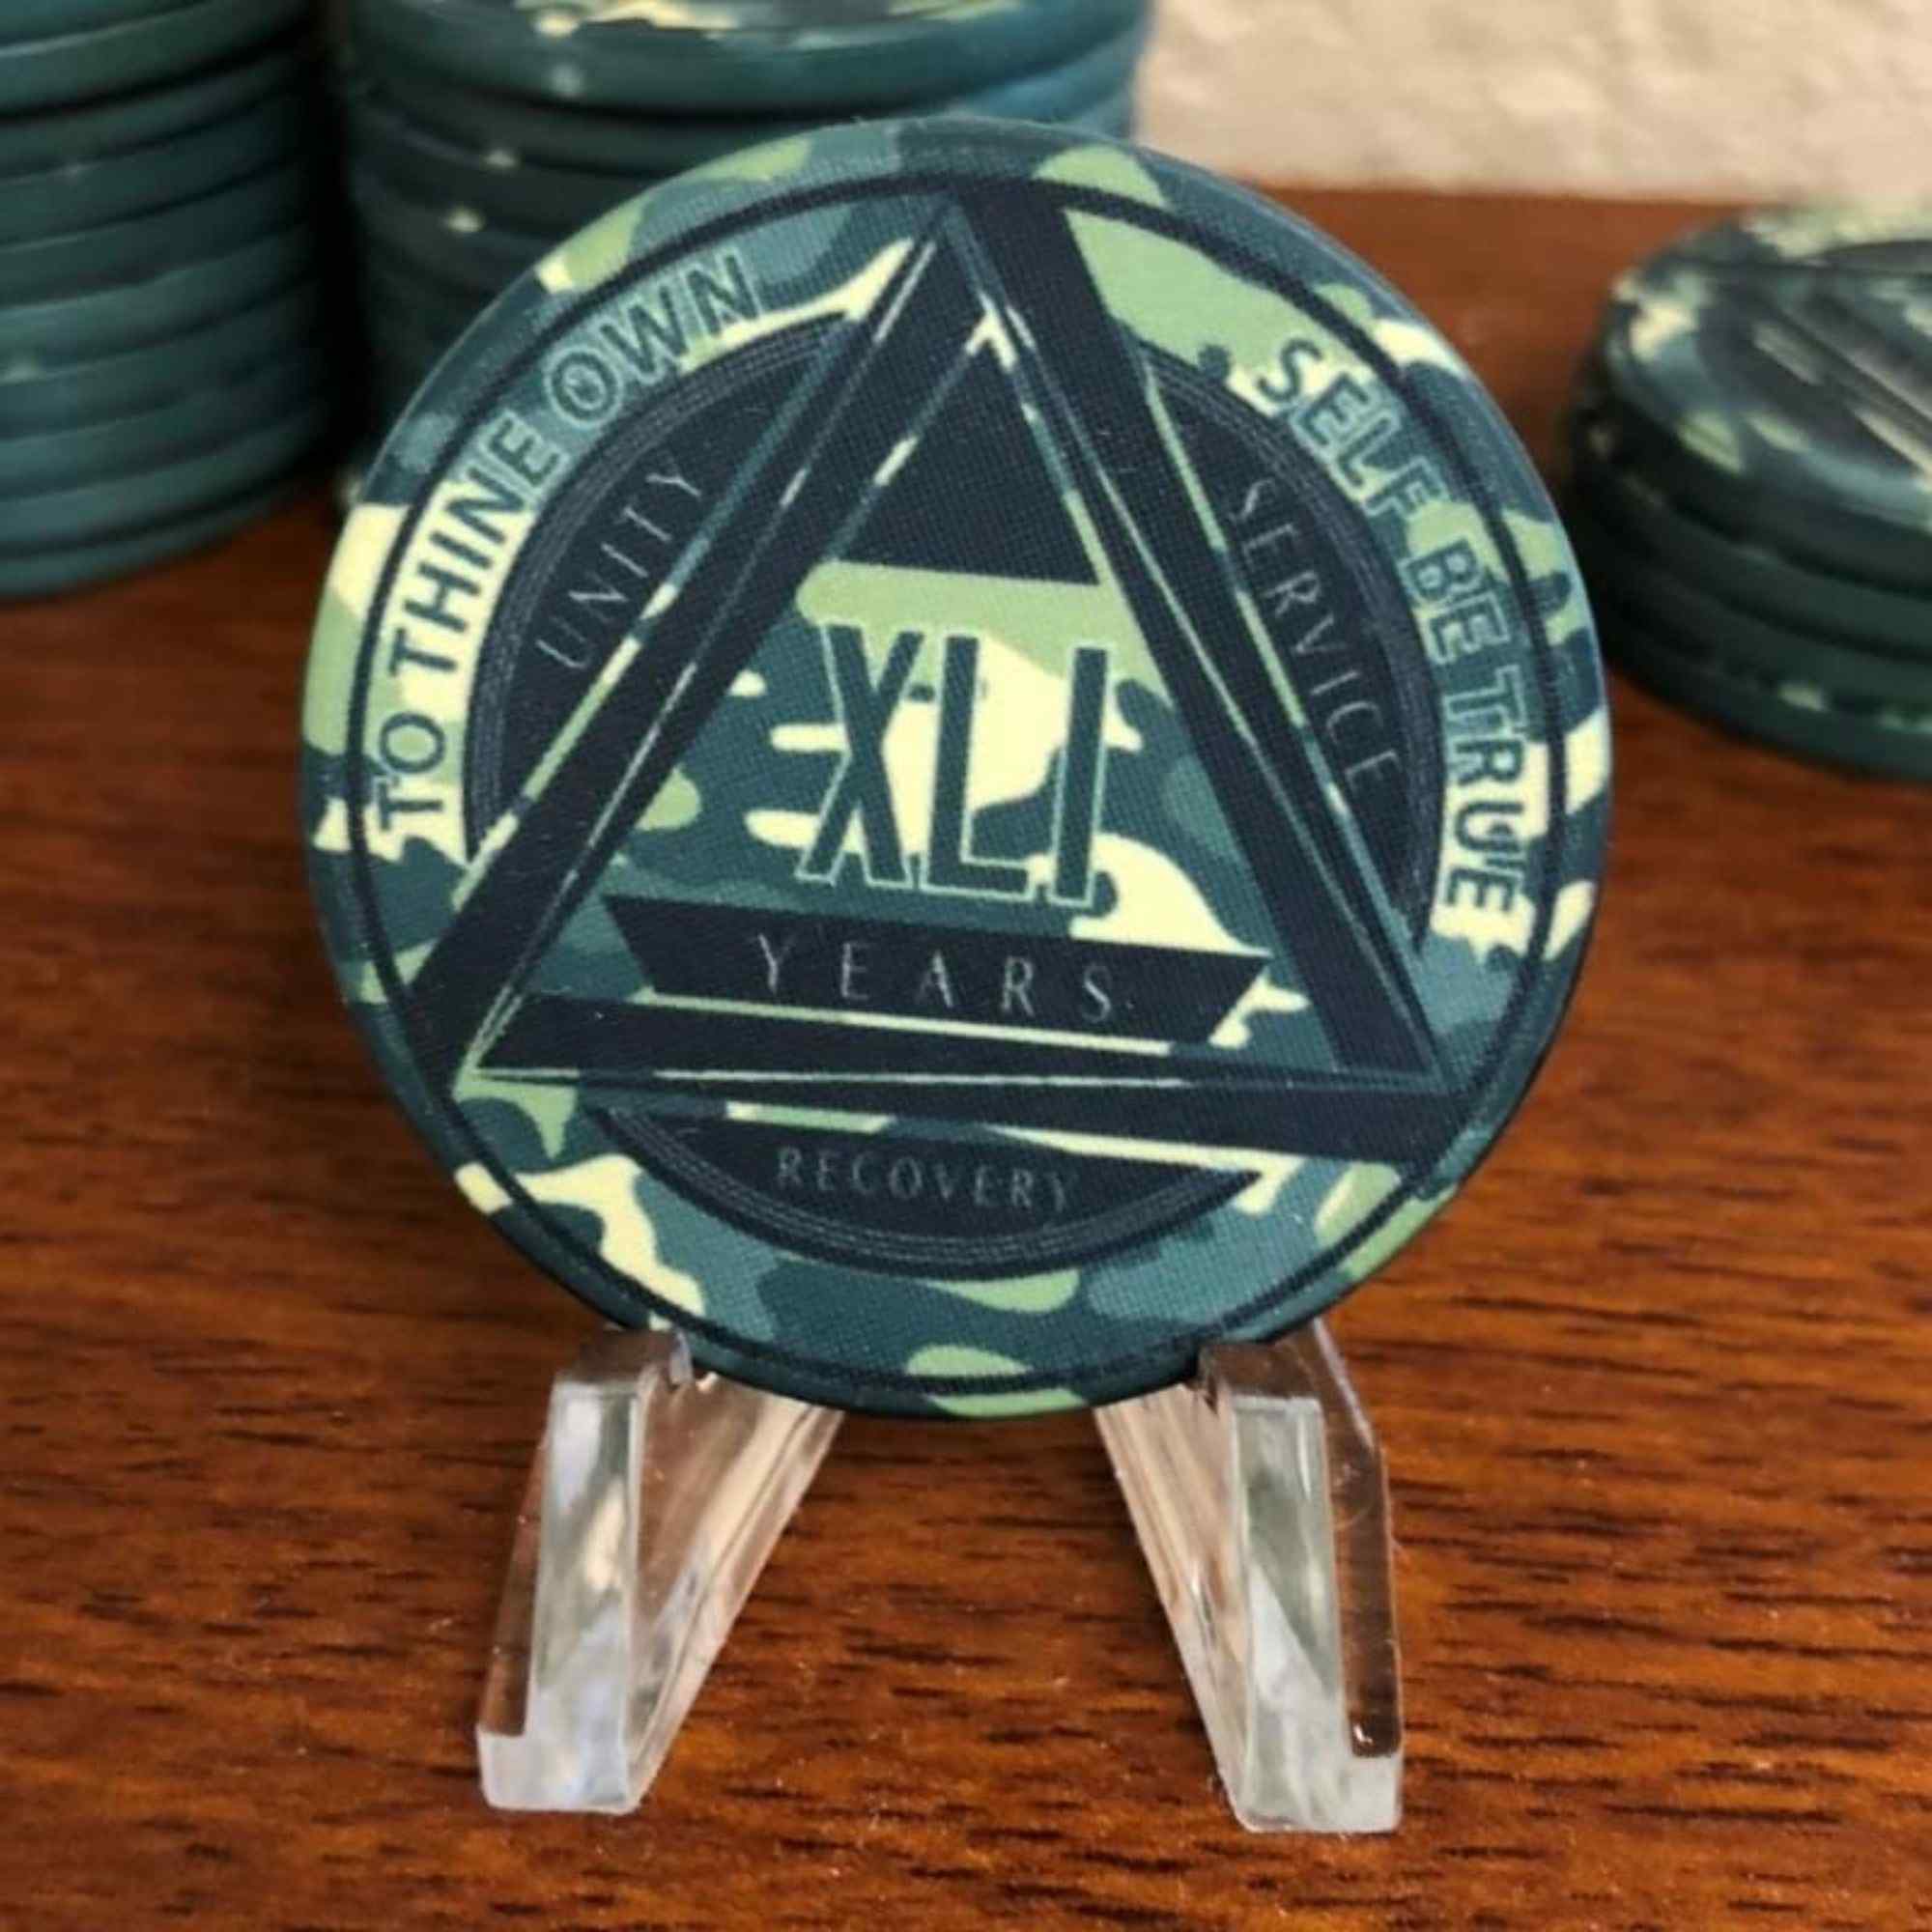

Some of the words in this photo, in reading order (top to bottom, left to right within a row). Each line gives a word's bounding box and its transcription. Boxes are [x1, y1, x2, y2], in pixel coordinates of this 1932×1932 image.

[543, 248, 766, 428] OWN
[1256, 338, 1447, 517] SELF
[388, 411, 570, 675] THINE
[535, 470, 701, 670] UNITY
[1229, 478, 1399, 784] SERVICE
[1400, 539, 1510, 665] BE
[377, 712, 445, 831] TO
[795, 622, 1109, 908] XLI
[1443, 665, 1530, 916] TRUE
[758, 932, 1114, 1024] YEARS
[777, 1146, 1080, 1213] RECOVERY
